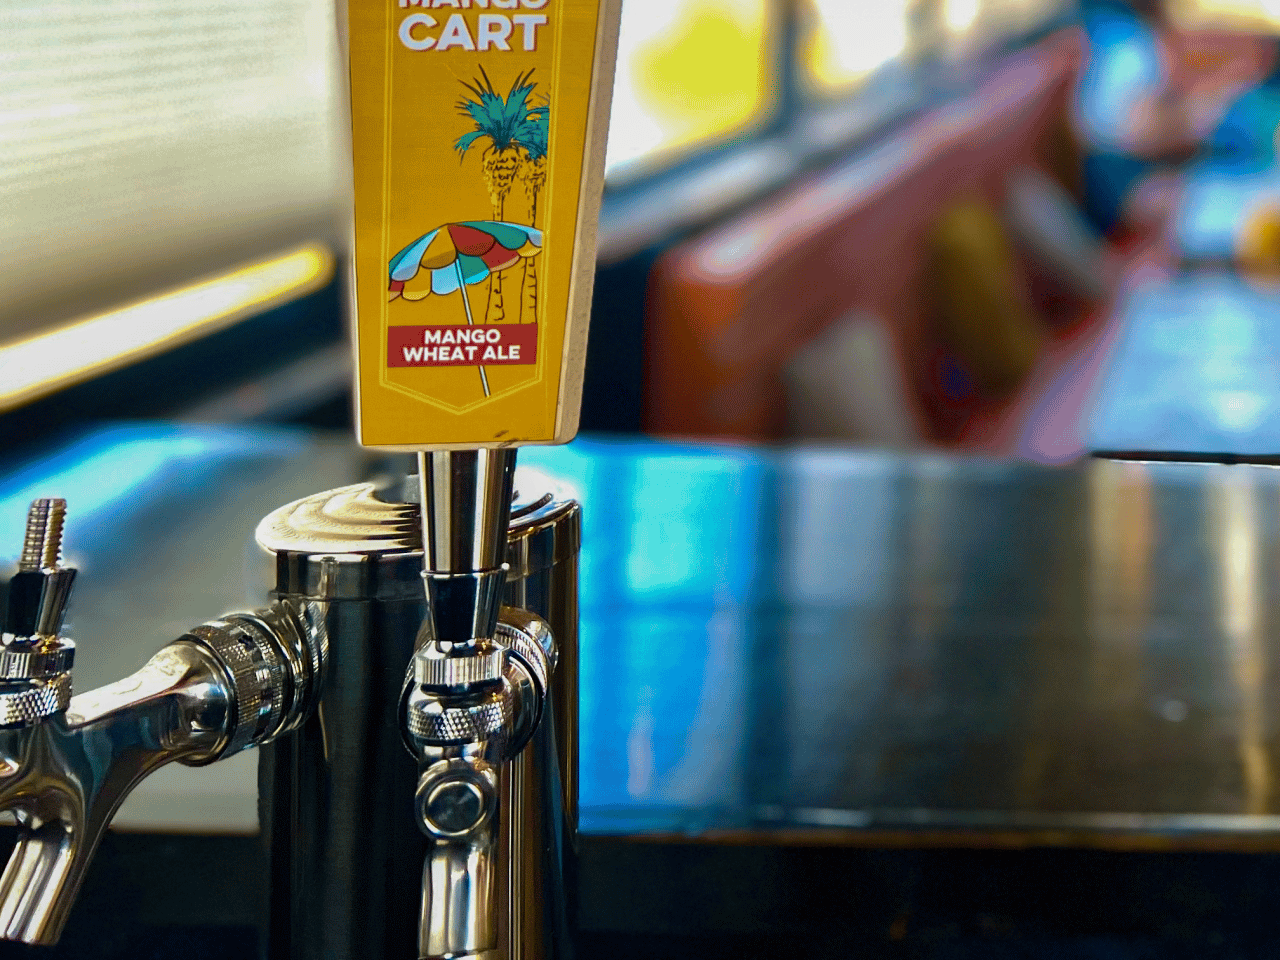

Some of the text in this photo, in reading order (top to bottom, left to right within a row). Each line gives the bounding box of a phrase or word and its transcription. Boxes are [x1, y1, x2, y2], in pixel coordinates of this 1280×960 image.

[398, 13, 548, 51] CART
[424, 329, 501, 344] MANGO
[403, 345, 521, 362] WHEAT ALE
